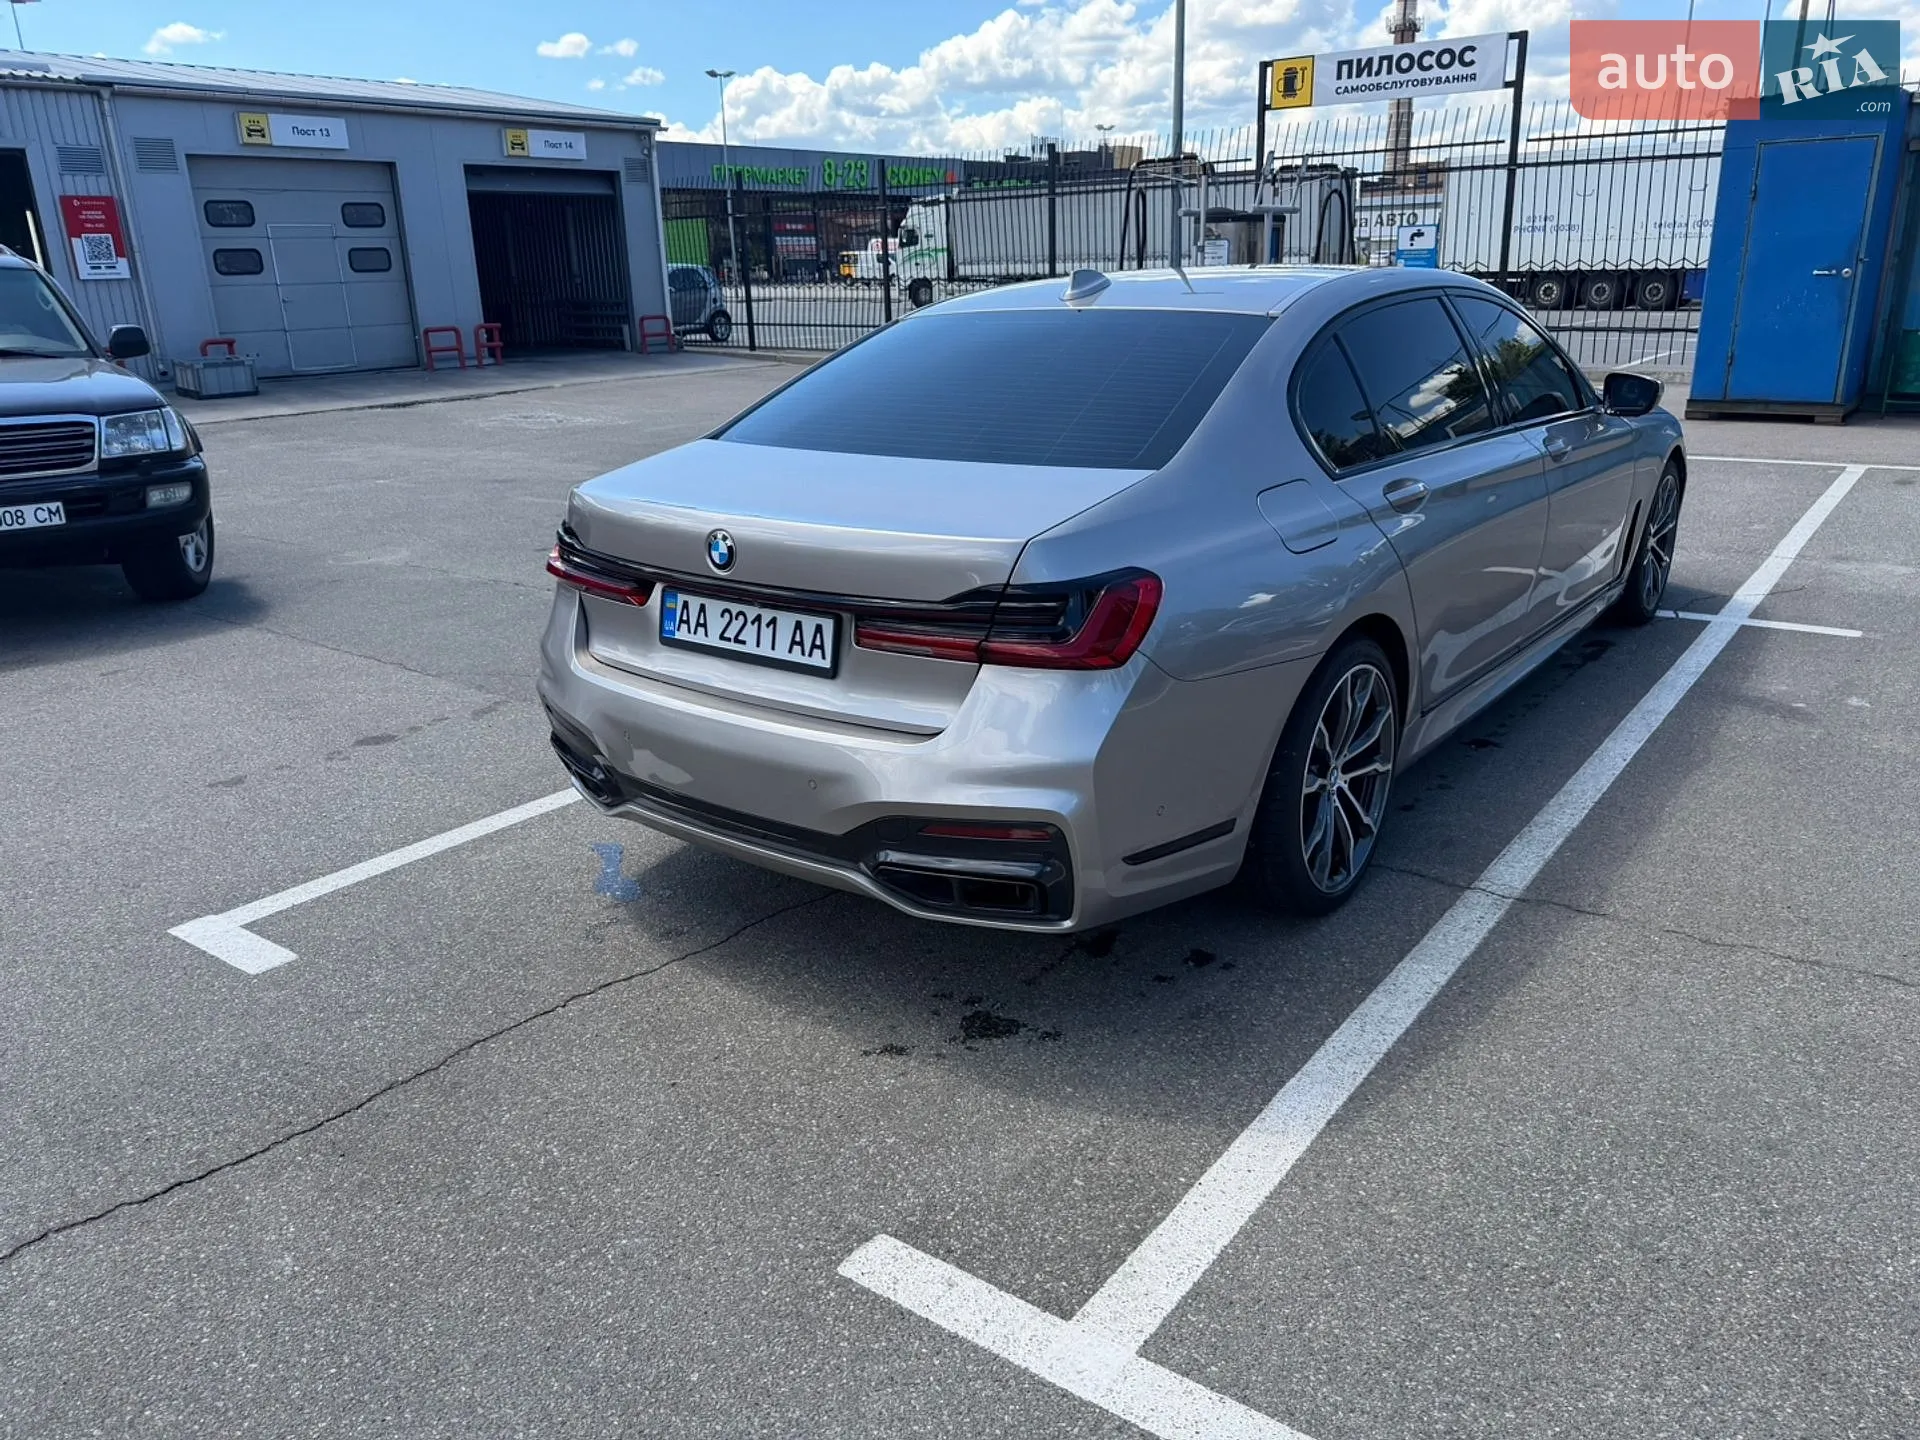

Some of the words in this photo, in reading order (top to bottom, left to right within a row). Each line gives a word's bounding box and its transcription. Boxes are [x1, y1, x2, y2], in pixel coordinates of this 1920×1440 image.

[1335, 45, 1478, 81] ПИЛОСОС
[1335, 72, 1477, 95] САМООБСЛУГОВУВАННЯ
[291, 126, 316, 136] Пост
[318, 127, 331, 137] 13
[543, 140, 562, 149] Пост
[564, 141, 574, 149] 14
[823, 159, 868, 187] 8-23
[1373, 211, 1419, 229] АВТО
[1653, 220, 1689, 229] teleax
[0, 509, 26, 527] 08
[34, 504, 63, 523] CM
[677, 600, 709, 638] AA
[718, 607, 778, 651] 2211
[788, 620, 826, 660] AA
